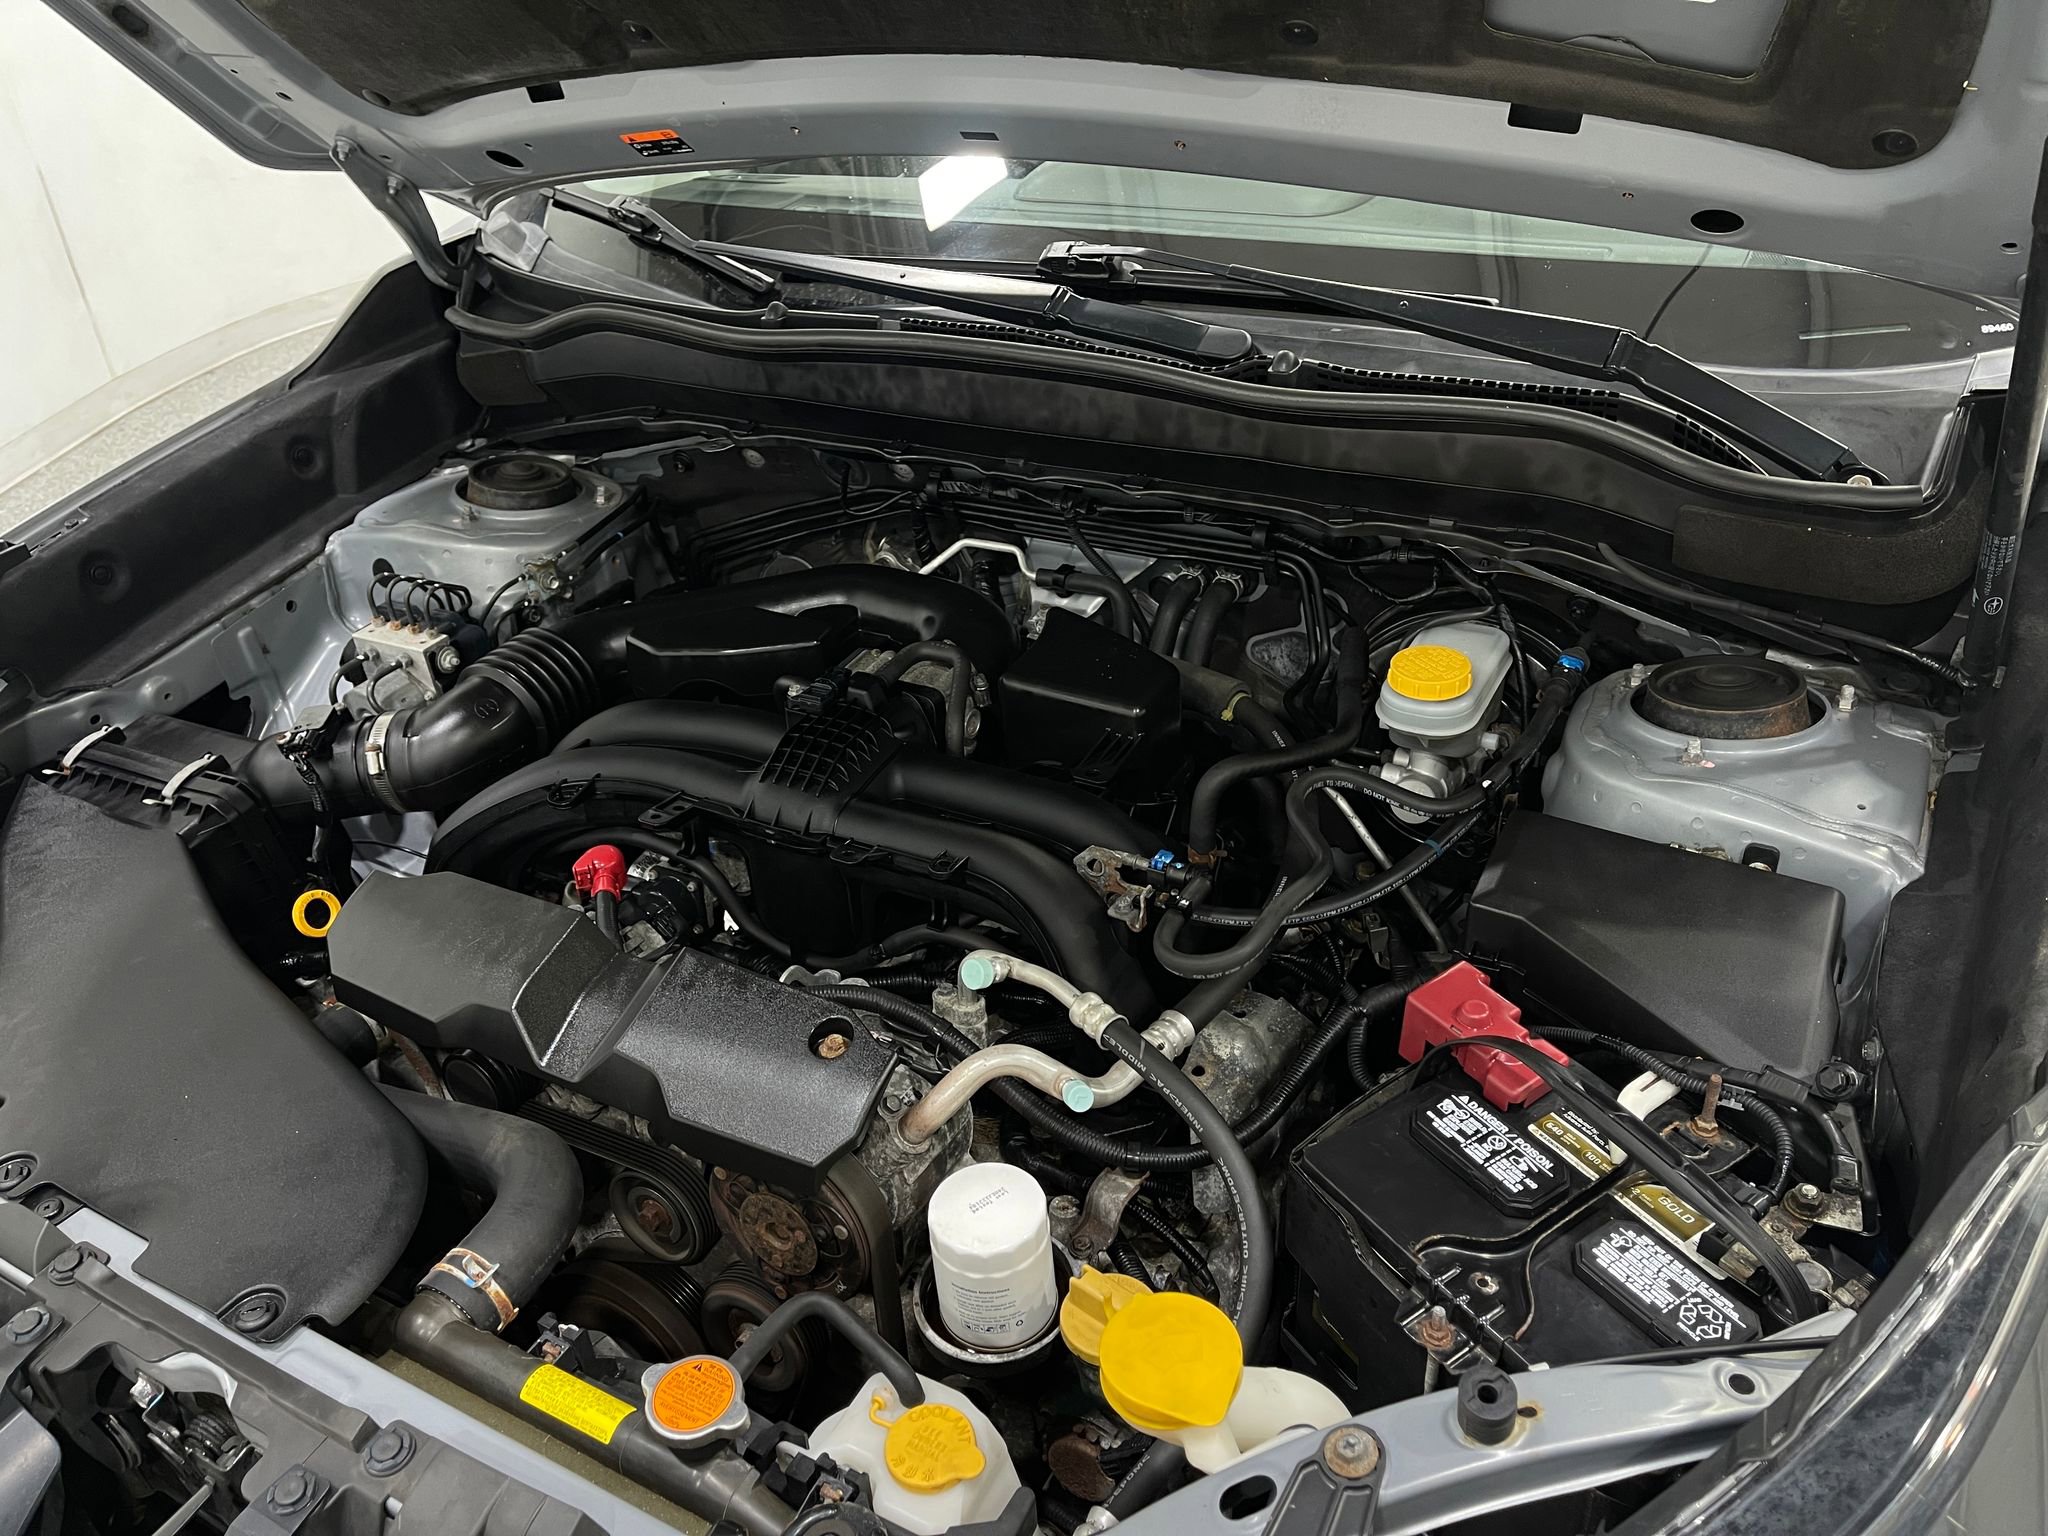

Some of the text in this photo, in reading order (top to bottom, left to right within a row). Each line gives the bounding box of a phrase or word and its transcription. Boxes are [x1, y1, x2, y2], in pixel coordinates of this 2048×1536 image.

[1467, 1100, 1508, 1133] DANGER
[1512, 1137, 1553, 1169] POISON
[1545, 1121, 1563, 1136] 640
[1584, 1151, 1601, 1165] 100
[1657, 1197, 1695, 1224] GOLD
[908, 1405, 972, 1444] COOLANT
